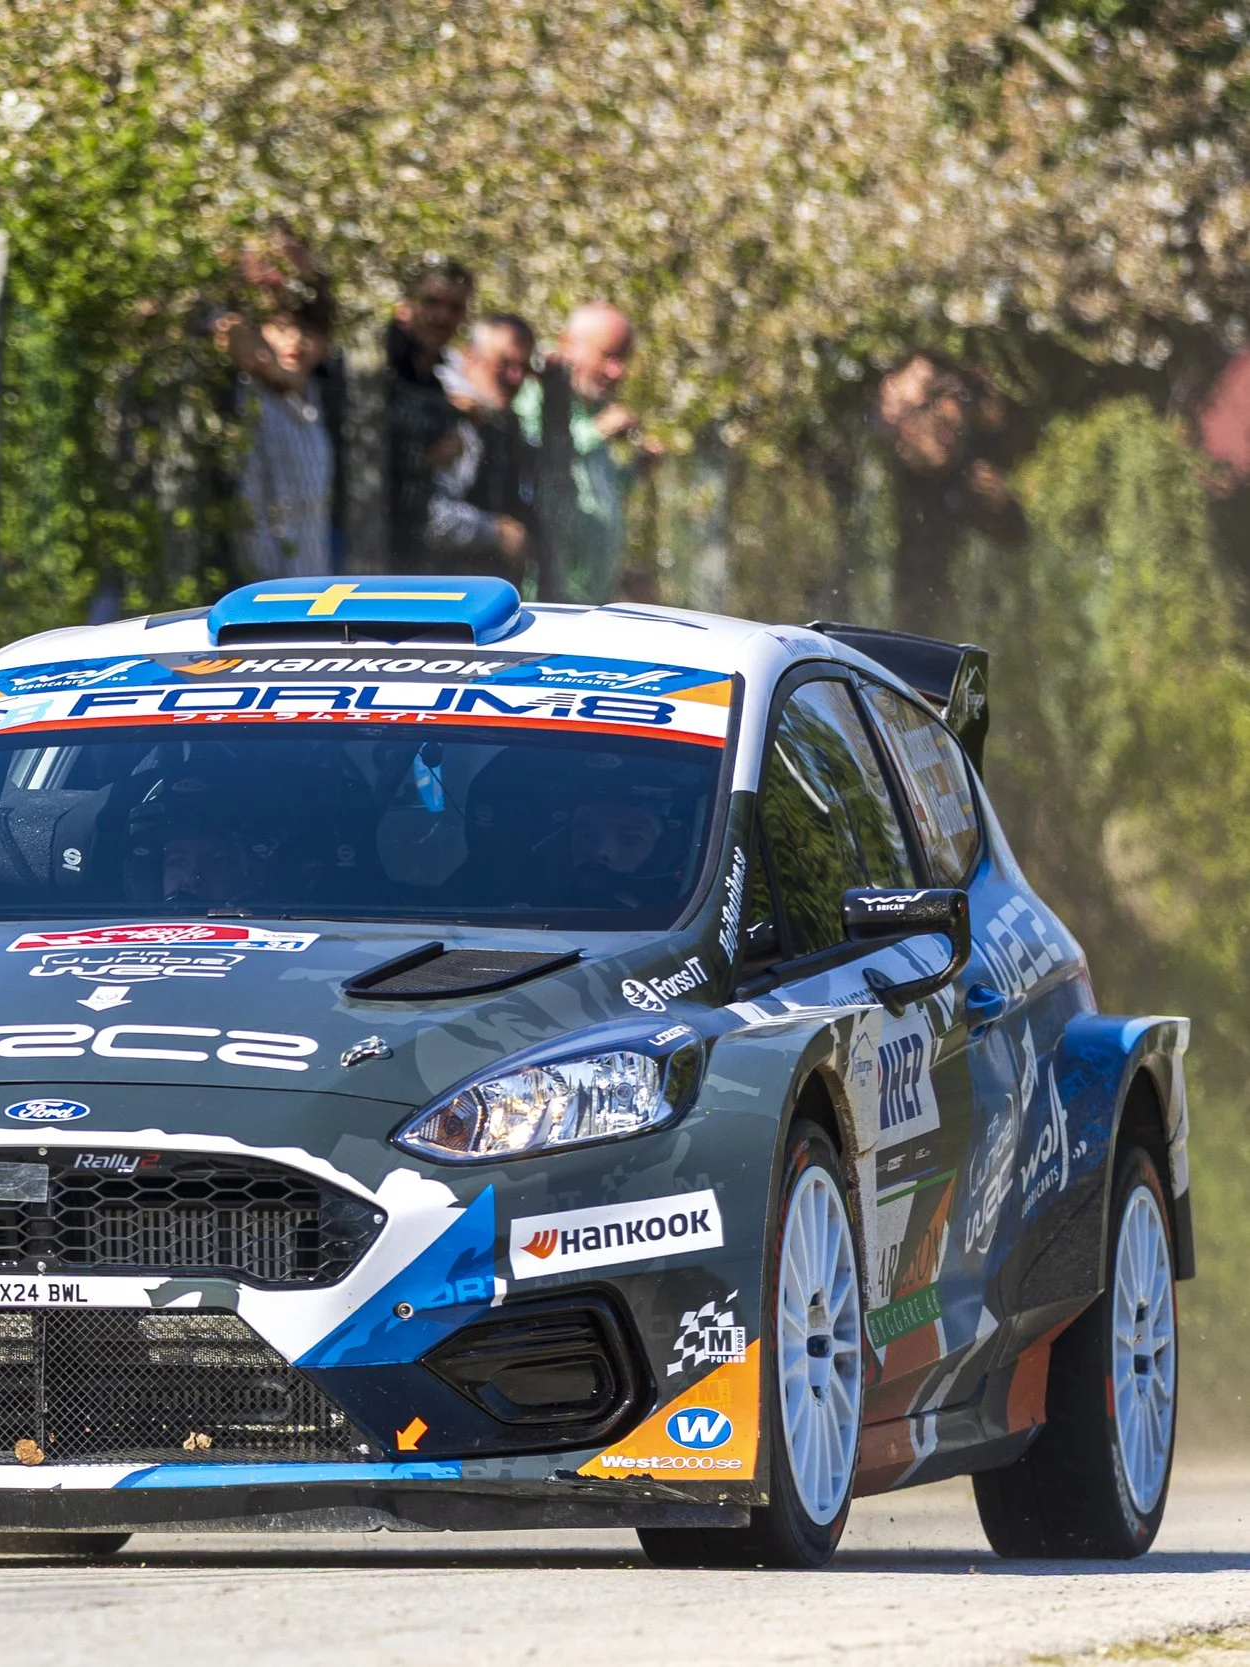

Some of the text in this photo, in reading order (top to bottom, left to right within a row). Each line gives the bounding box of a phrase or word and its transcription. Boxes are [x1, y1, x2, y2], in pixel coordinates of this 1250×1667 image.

[67, 686, 676, 725] FORUM8
[51, 956, 228, 965] JUNIOR
[29, 965, 232, 977] WRC
[648, 956, 708, 1001] Forss IT
[18, 1101, 77, 1118] Ford
[48, 1283, 88, 1303] BWL
[870, 1298, 924, 1343] BYGGARE
[708, 1328, 744, 1353] M SPORT
[710, 1355, 747, 1364] POLAND
[676, 1411, 728, 1443] W
[601, 1456, 742, 1470] West2000.se
